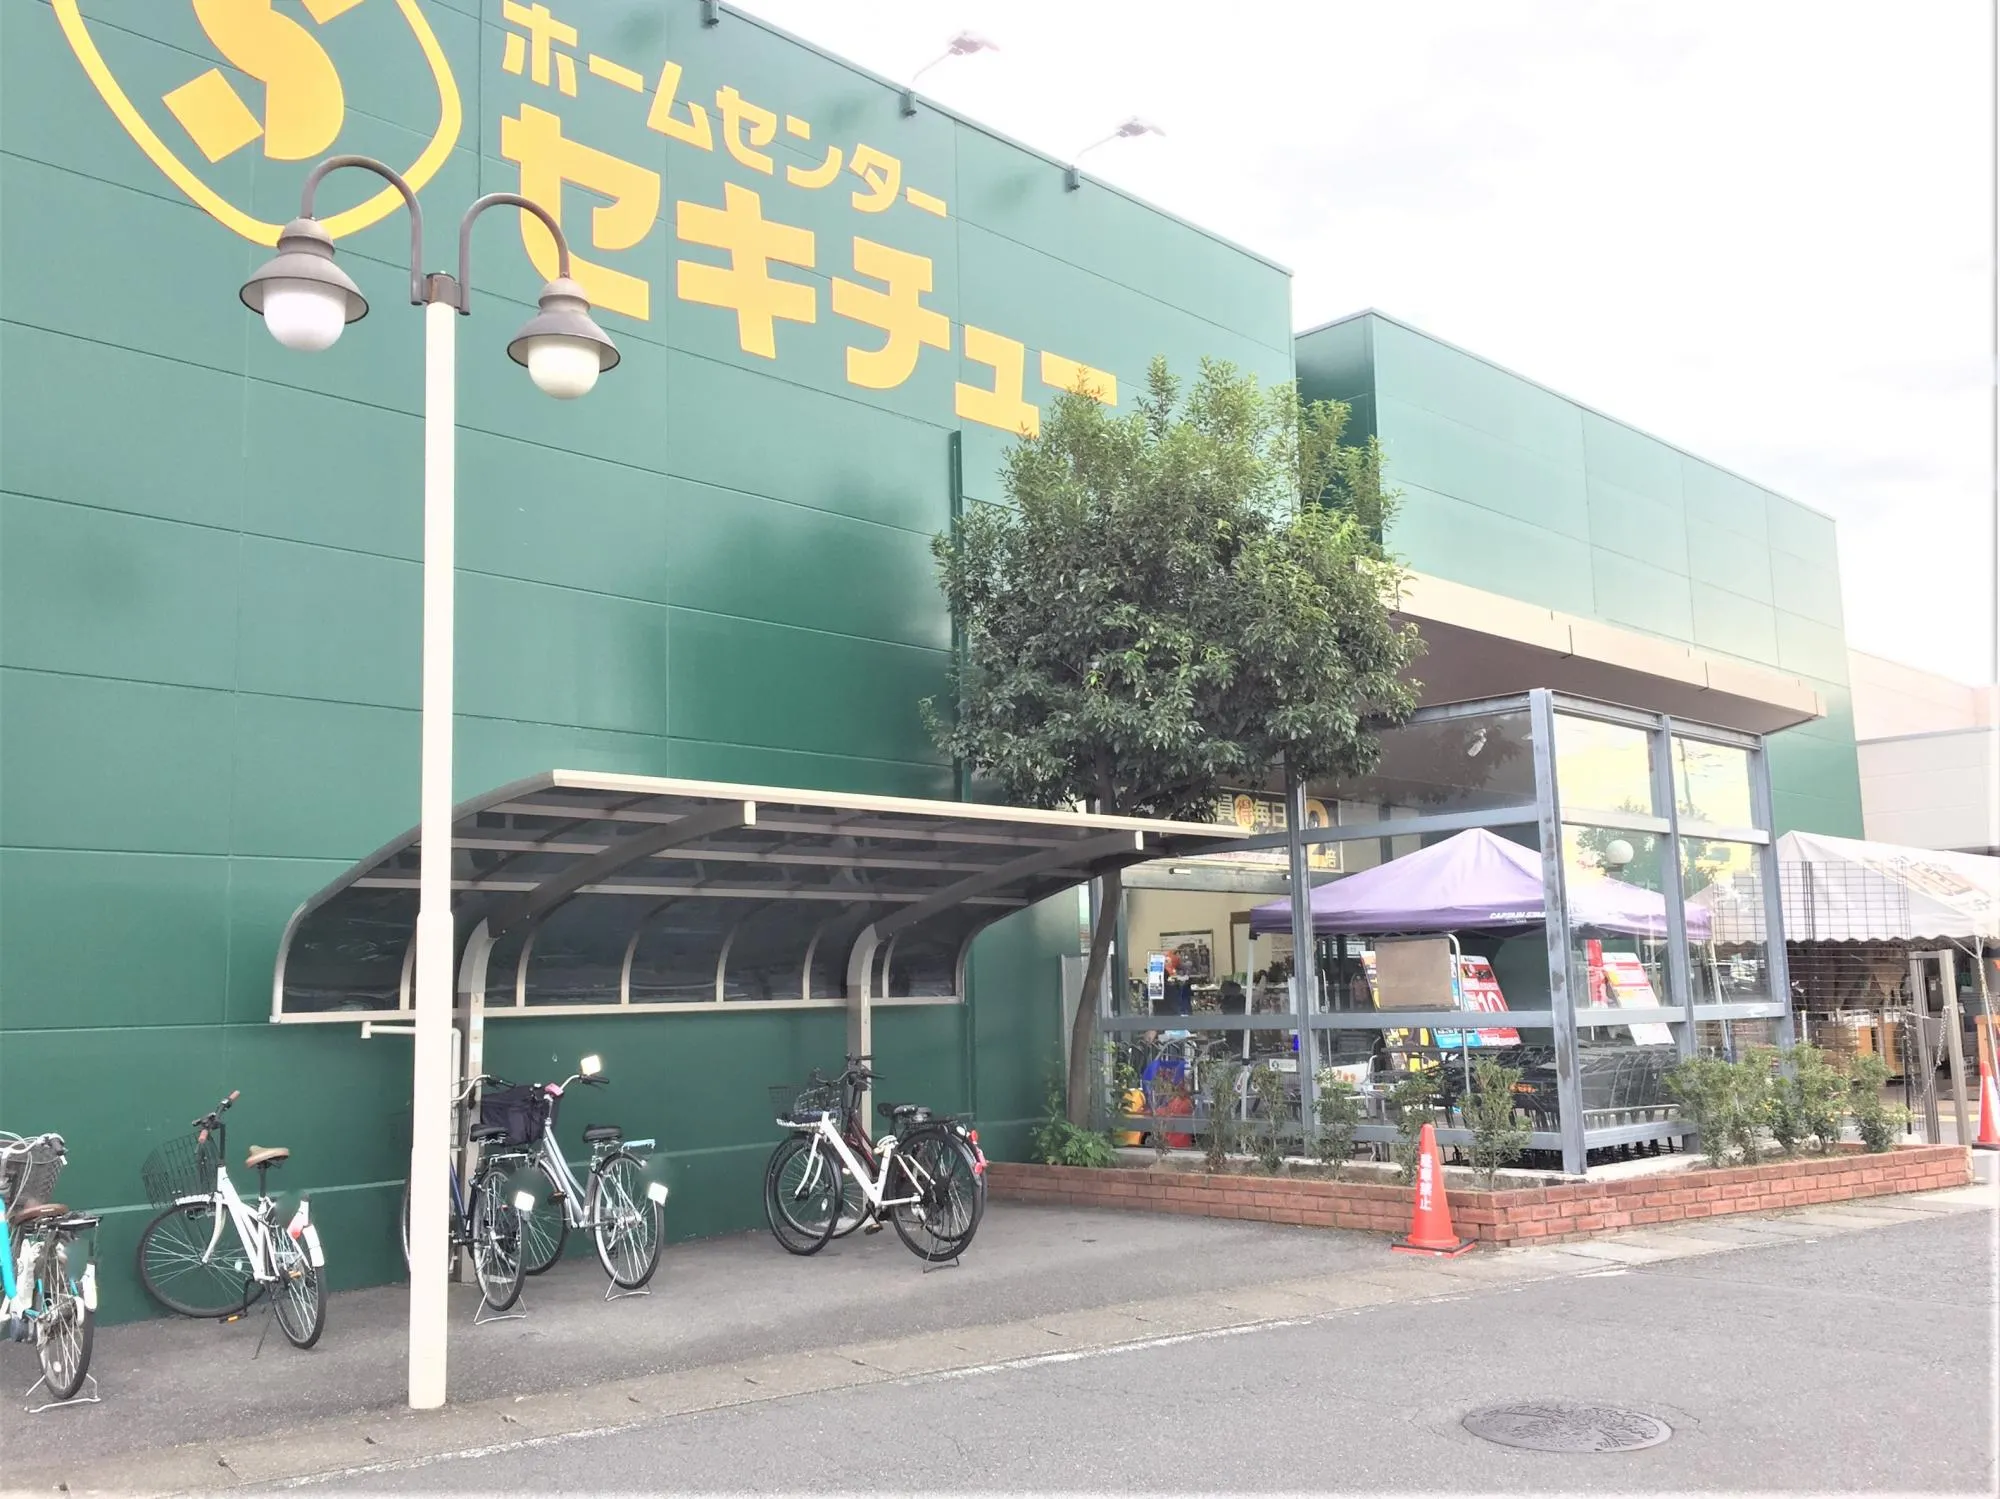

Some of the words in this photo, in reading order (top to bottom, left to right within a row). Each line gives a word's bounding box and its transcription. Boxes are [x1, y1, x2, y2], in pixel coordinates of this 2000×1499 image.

[502, 0, 947, 218] ホームセンター
[501, 103, 1117, 437] セキチュー
